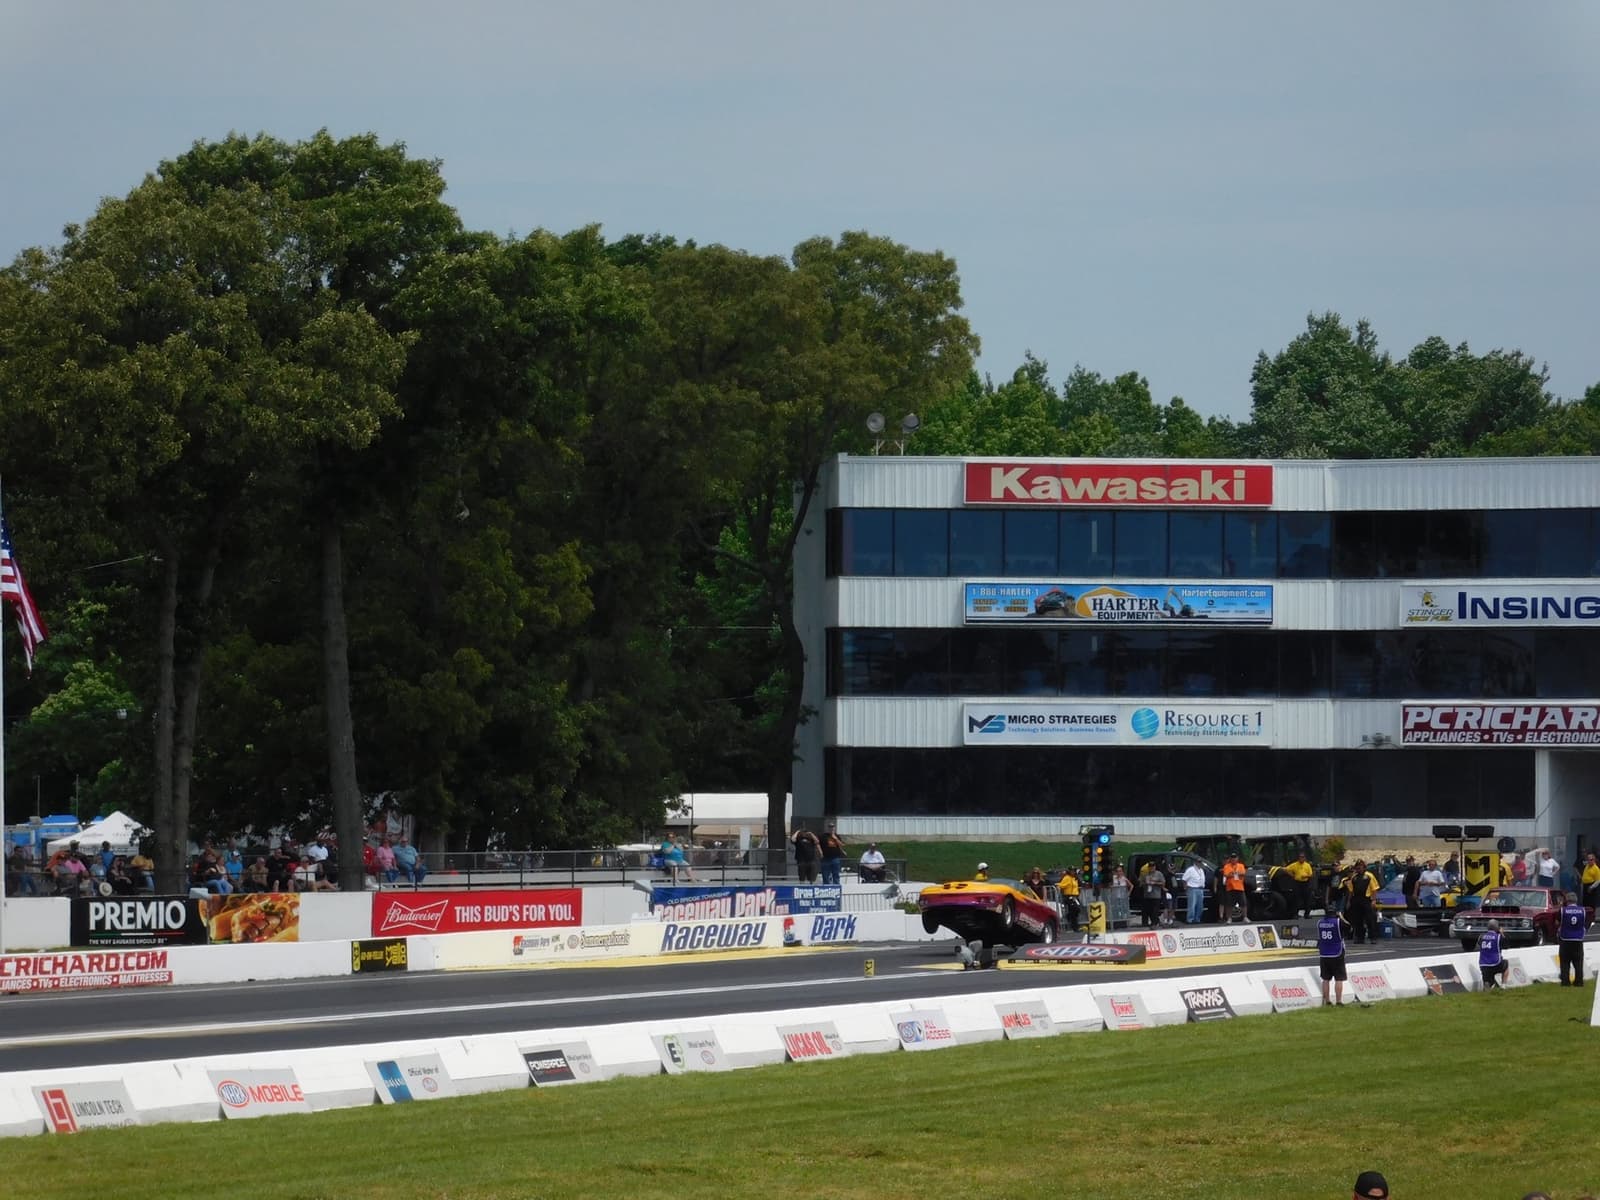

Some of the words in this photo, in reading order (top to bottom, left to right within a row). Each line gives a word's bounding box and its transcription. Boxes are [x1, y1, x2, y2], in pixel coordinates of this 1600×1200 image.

[990, 466, 1246, 502] Kawasaki
[1181, 588, 1267, 598] HarterEquipment.com
[1092, 598, 1159, 611] HARTER
[1407, 608, 1454, 616] STINGER
[1097, 611, 1155, 620] EQUIPMENT
[1008, 715, 1045, 724] MICRO
[1048, 715, 1117, 724] STRATEGIES
[1164, 710, 1249, 727] RESOURCE
[1404, 707, 1600, 730] PCRICHAR
[1404, 731, 1482, 743] APPLIANCES
[1492, 732, 1514, 743] TVs
[655, 896, 732, 921] Raceway
[735, 888, 776, 917] Park
[89, 900, 187, 931] PREMIO
[386, 908, 441, 923] Budweiser
[454, 905, 481, 923] THIS
[484, 904, 520, 922] BUD'S
[522, 904, 546, 921] FOR
[548, 904, 575, 921] YOU.
[1570, 916, 1577, 925] 9
[811, 914, 857, 941] Park
[1321, 930, 1333, 940] 86
[660, 922, 768, 952] Raceway
[1037, 945, 1112, 957] NHRA
[59, 975, 113, 988] ELECTRONICS
[119, 971, 169, 985] MATTRESSES
[1359, 975, 1386, 992] TOYOTA
[1278, 986, 1308, 998] HONDA
[783, 1032, 817, 1059] LUCAS
[248, 1084, 305, 1103] MOBILE
[72, 1100, 104, 1118] LINCOLN
[103, 1099, 124, 1115] TECH
